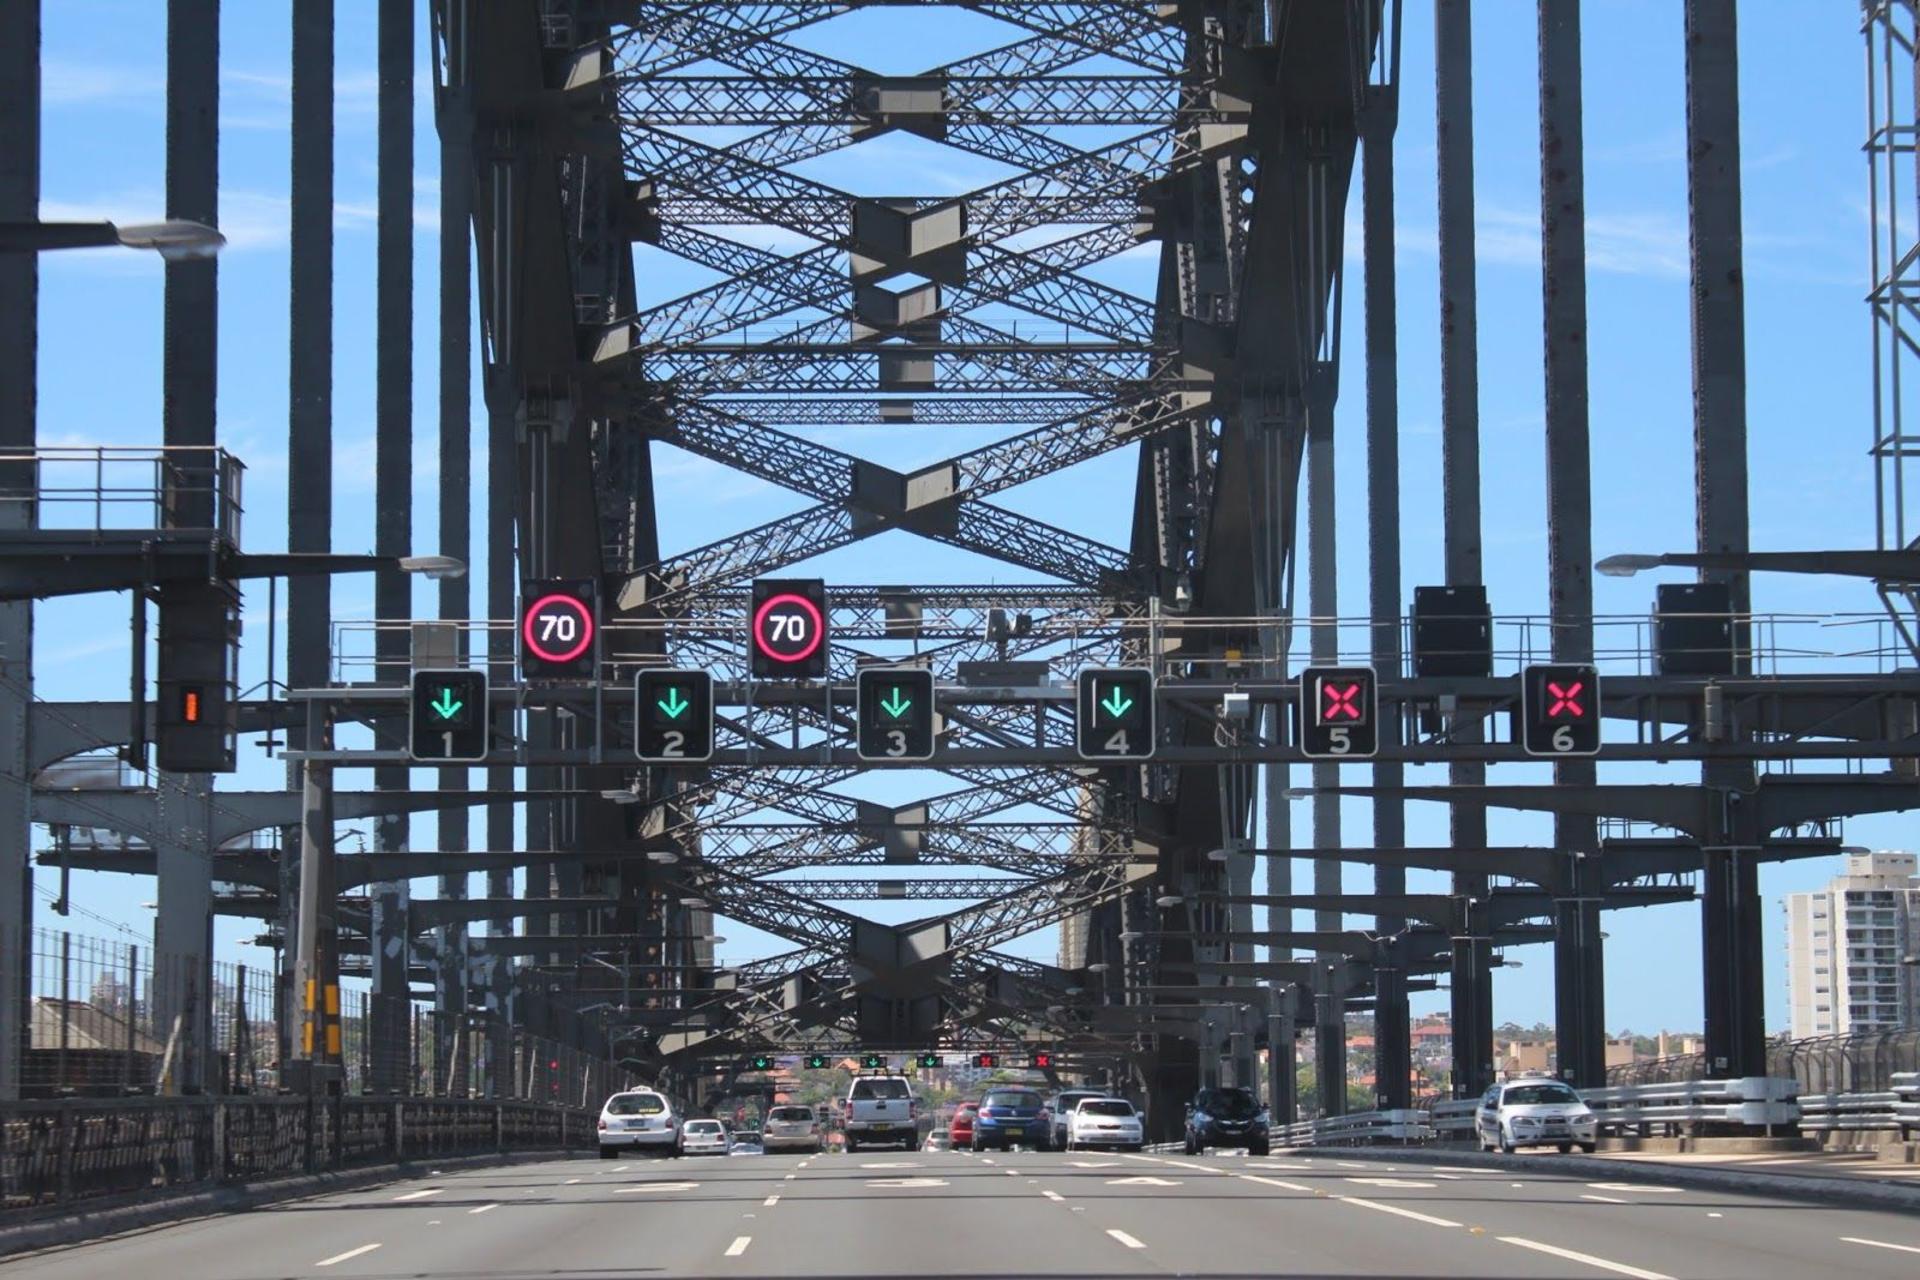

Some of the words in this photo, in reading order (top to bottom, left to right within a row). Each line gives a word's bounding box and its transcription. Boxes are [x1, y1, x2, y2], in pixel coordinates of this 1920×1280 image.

[540, 616, 575, 641] 70
[770, 616, 805, 641] 70
[441, 731, 452, 756] 1
[663, 731, 684, 756] 2
[886, 731, 906, 756] 3
[1104, 730, 1130, 755] 4
[1330, 728, 1350, 753] 5
[1553, 726, 1574, 751] 6
